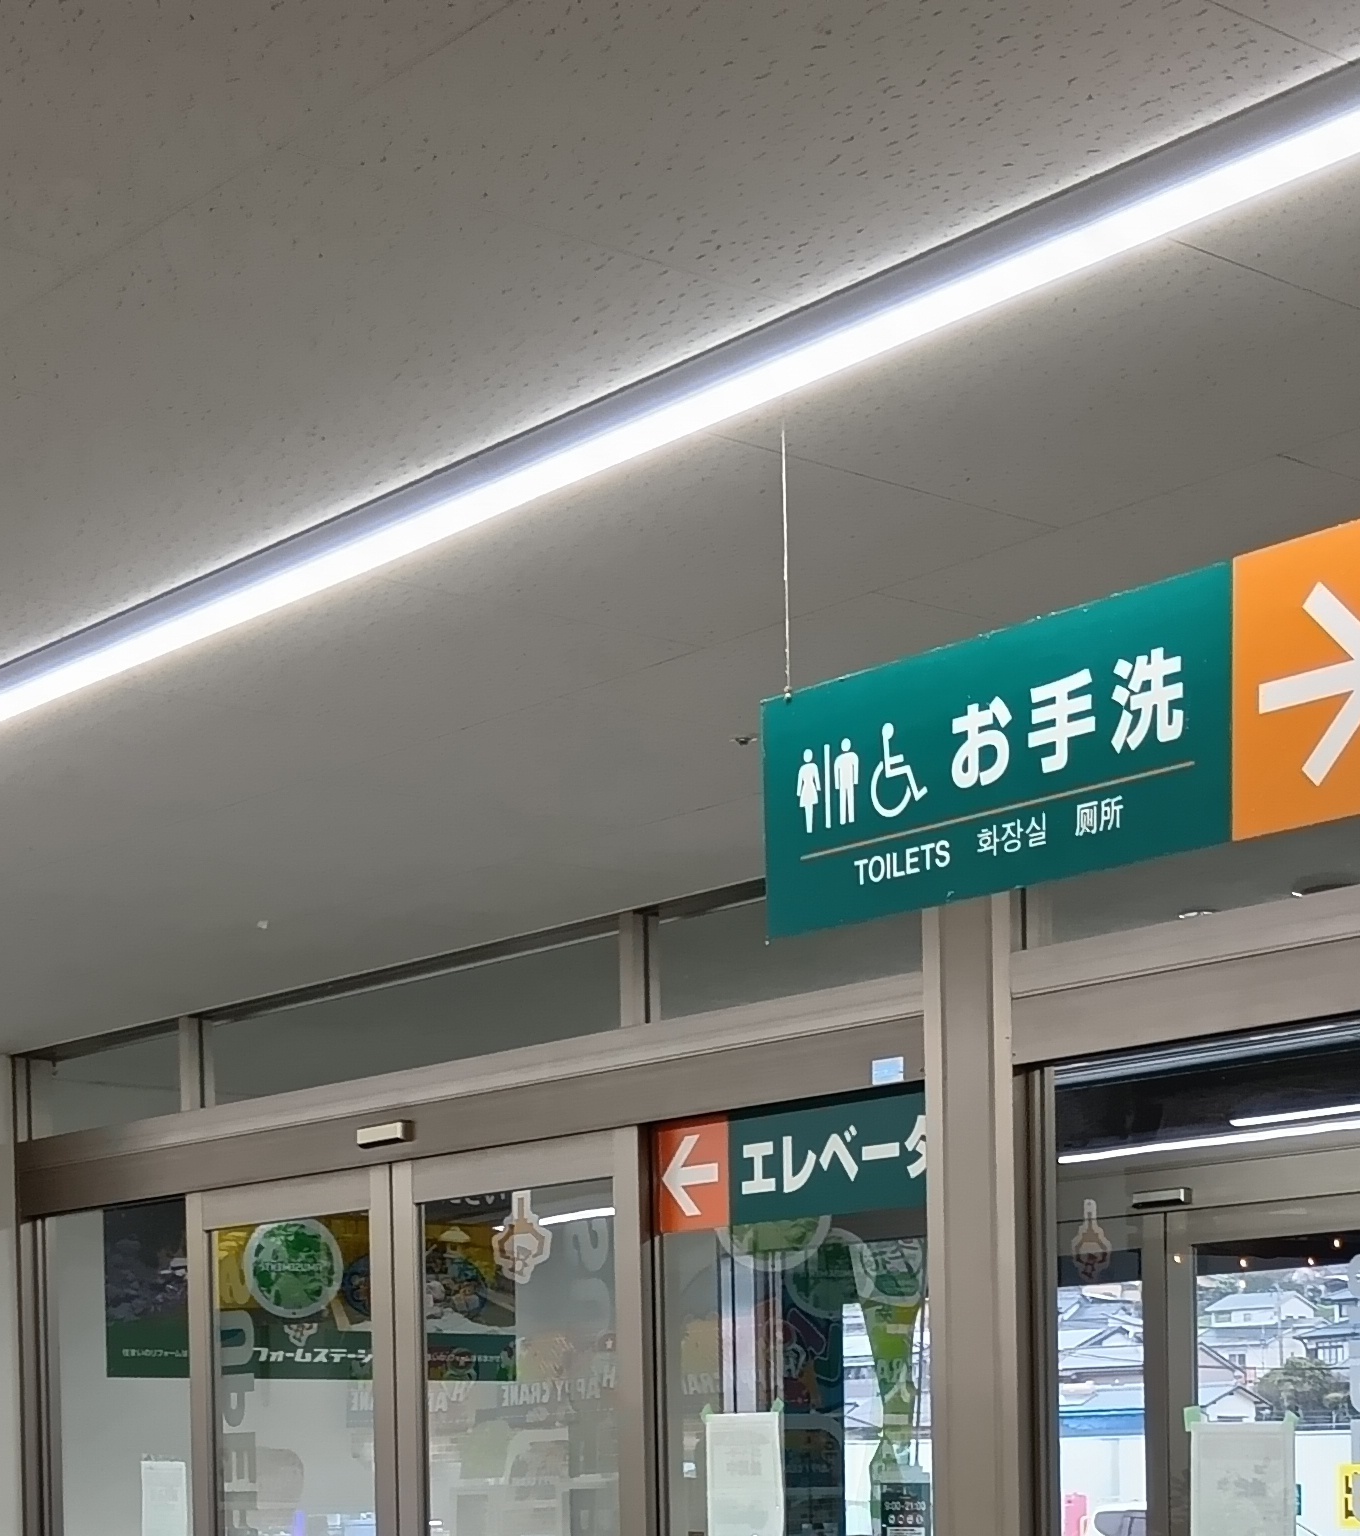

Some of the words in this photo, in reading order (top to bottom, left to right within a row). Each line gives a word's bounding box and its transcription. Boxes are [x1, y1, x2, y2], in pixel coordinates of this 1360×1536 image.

[950, 647, 1184, 790] お手洗
[976, 812, 1048, 857] 화장실
[853, 839, 951, 886] TOILETS
